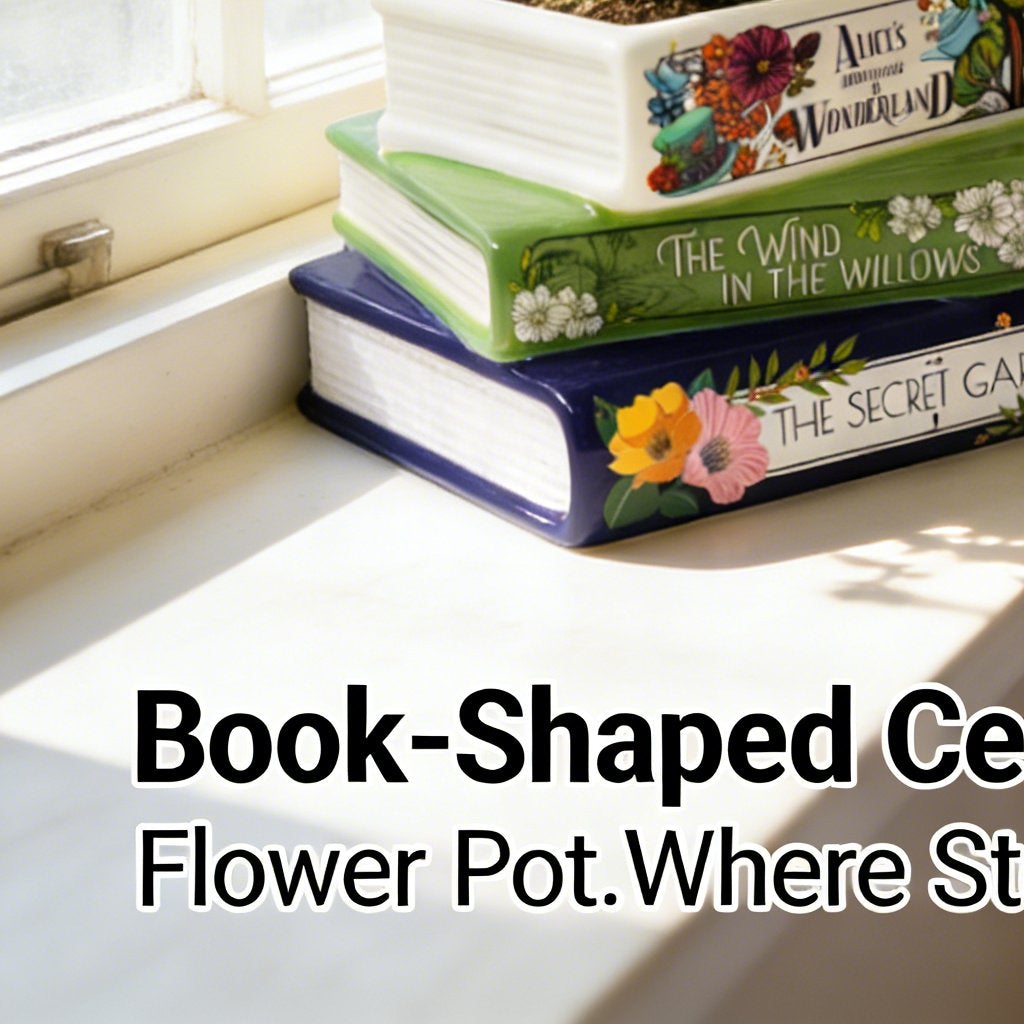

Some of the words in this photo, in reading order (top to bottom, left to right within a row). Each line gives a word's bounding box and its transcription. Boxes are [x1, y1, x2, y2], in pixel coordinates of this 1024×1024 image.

[792, 70, 955, 153] WONDERLAND
[656, 228, 725, 277] THE
[737, 216, 841, 266] WIND
[722, 273, 752, 306] IN
[767, 262, 828, 300] THE
[839, 243, 982, 291] WILLOWS
[773, 396, 835, 447] THE
[846, 367, 950, 429] SECRET
